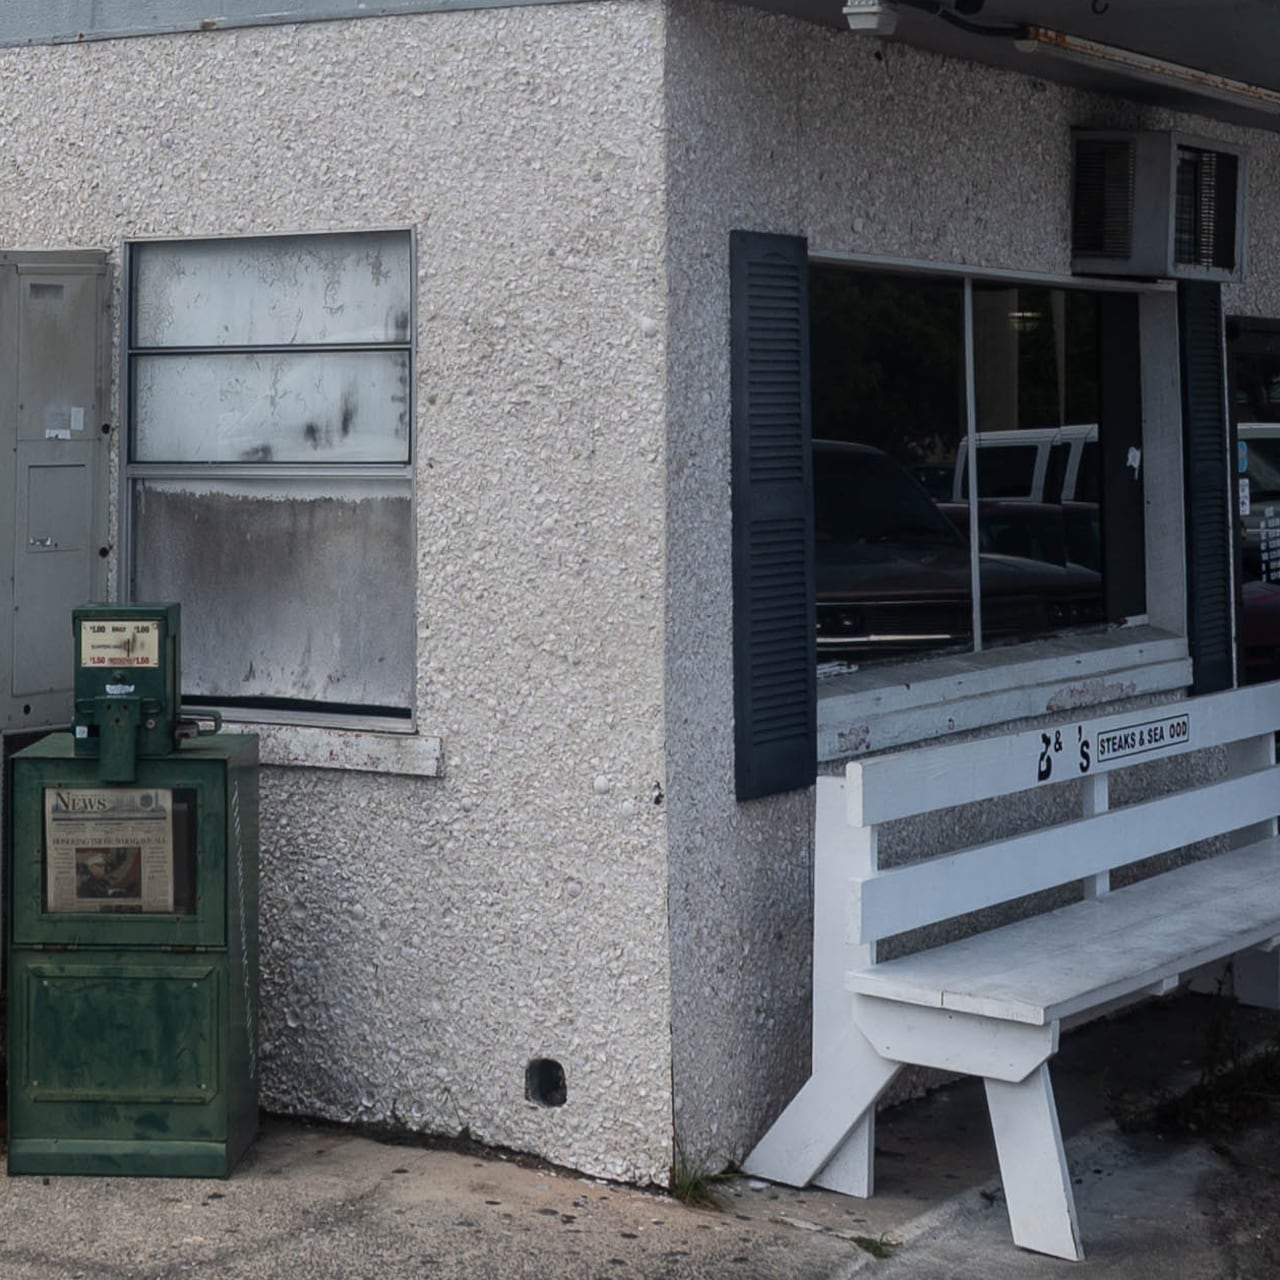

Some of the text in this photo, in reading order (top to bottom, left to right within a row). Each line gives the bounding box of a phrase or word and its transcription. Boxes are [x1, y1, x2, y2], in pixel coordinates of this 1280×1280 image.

[1099, 721, 1187, 755] STEAKS & SEAOOD
